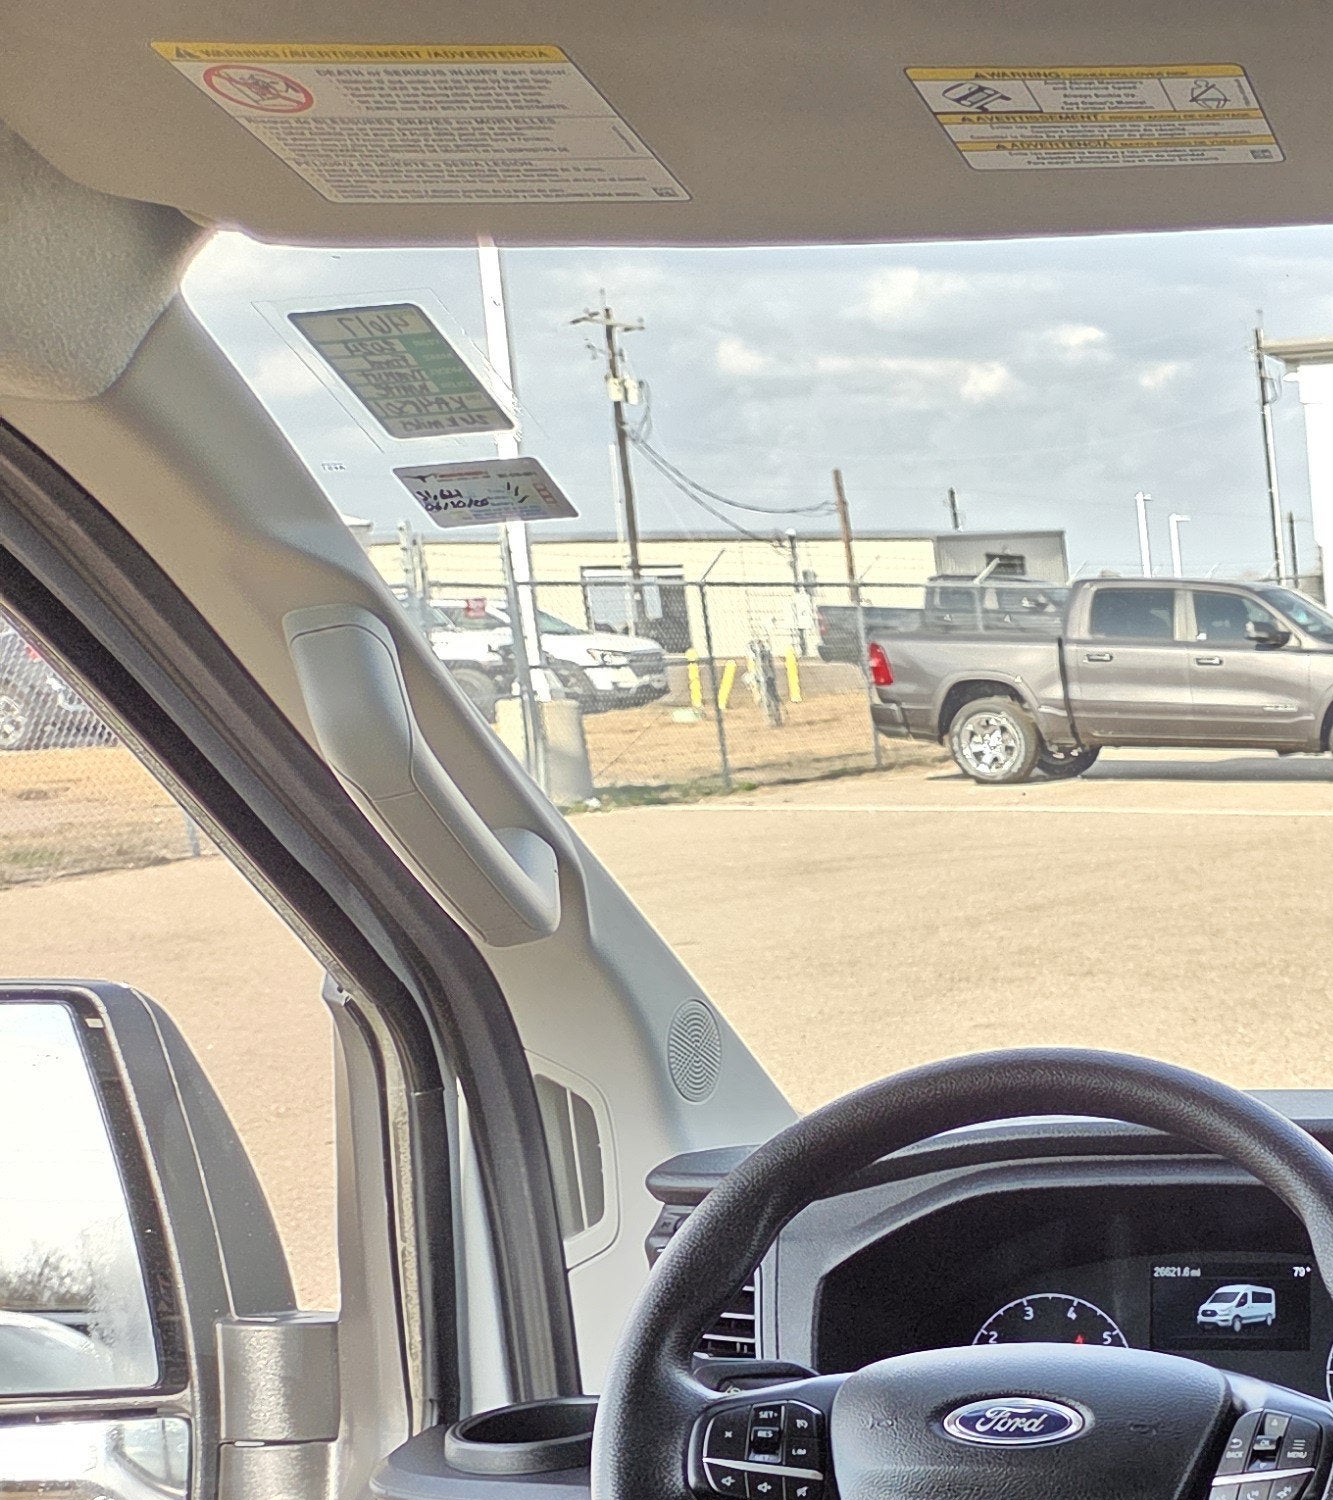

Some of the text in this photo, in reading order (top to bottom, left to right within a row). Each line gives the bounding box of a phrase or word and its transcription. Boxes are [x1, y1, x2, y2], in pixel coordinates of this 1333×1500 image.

[1023, 1306, 1034, 1321] 3
[1066, 1306, 1078, 1321] 4
[988, 1331, 999, 1344] 2
[1102, 1331, 1112, 1345] 5
[975, 1406, 1049, 1433] Ford
